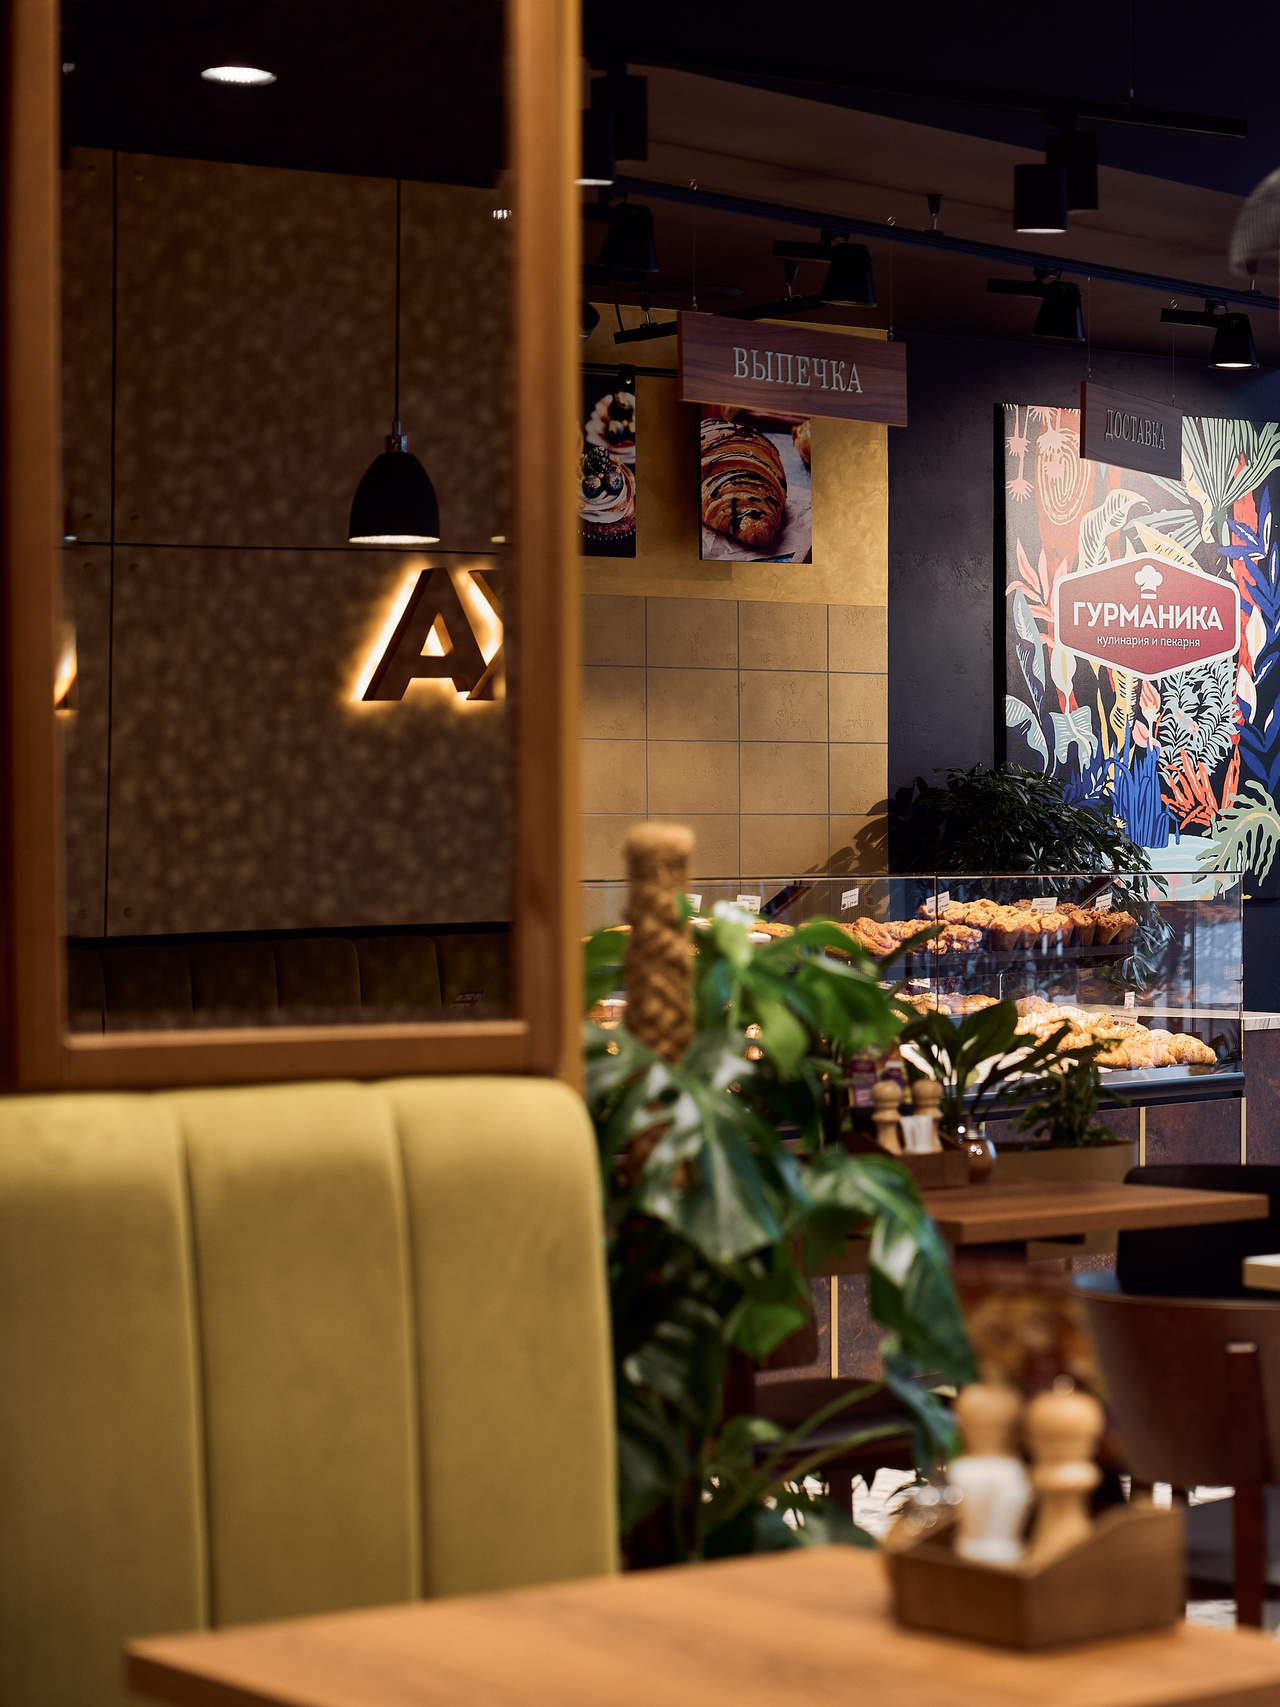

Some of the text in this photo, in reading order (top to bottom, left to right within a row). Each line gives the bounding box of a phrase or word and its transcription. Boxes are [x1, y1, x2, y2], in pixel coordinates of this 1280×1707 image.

[732, 346, 864, 394] ВЫПЕЧКА
[1104, 408, 1167, 451] ДОСТАВКА
[1073, 601, 1224, 631] ГУРМАНИКА
[1097, 634, 1200, 648] кулинария и пекарня
